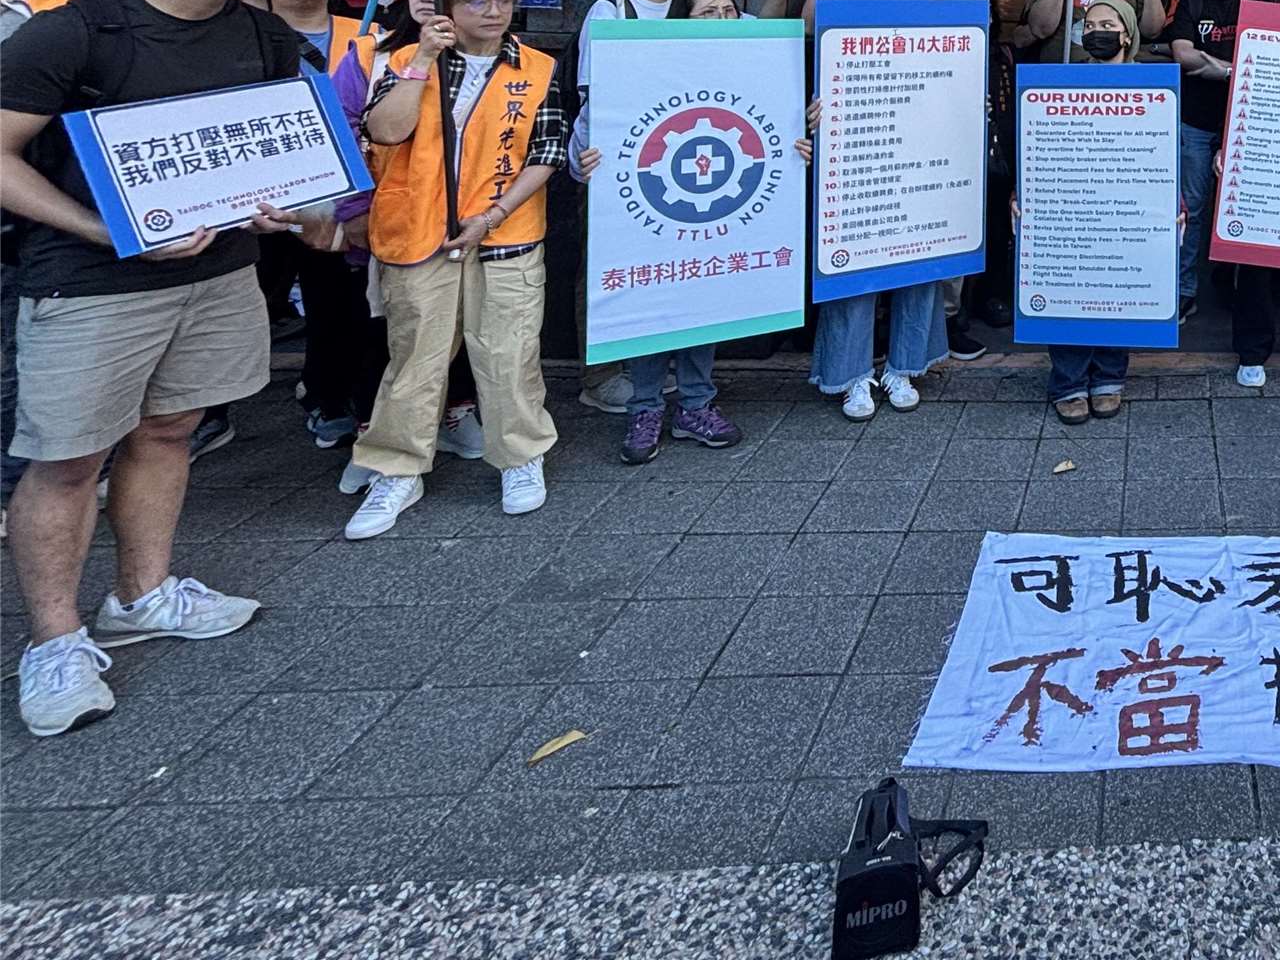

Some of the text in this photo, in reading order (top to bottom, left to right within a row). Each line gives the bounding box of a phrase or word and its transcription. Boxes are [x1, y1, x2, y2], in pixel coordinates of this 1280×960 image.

[1246, 33, 1258, 41] 12
[1027, 93, 1166, 103] OUR UNION'S 14
[1046, 105, 1146, 116] DEMANDS
[112, 108, 320, 166] 資方打壓無所不在
[122, 127, 327, 189] 我們反對不當對待
[616, 90, 783, 237] TAIDOC TECHNOLOGY LABOR UNION
[677, 224, 730, 242] TTLU
[601, 245, 794, 292] 泰博科技企業工會
